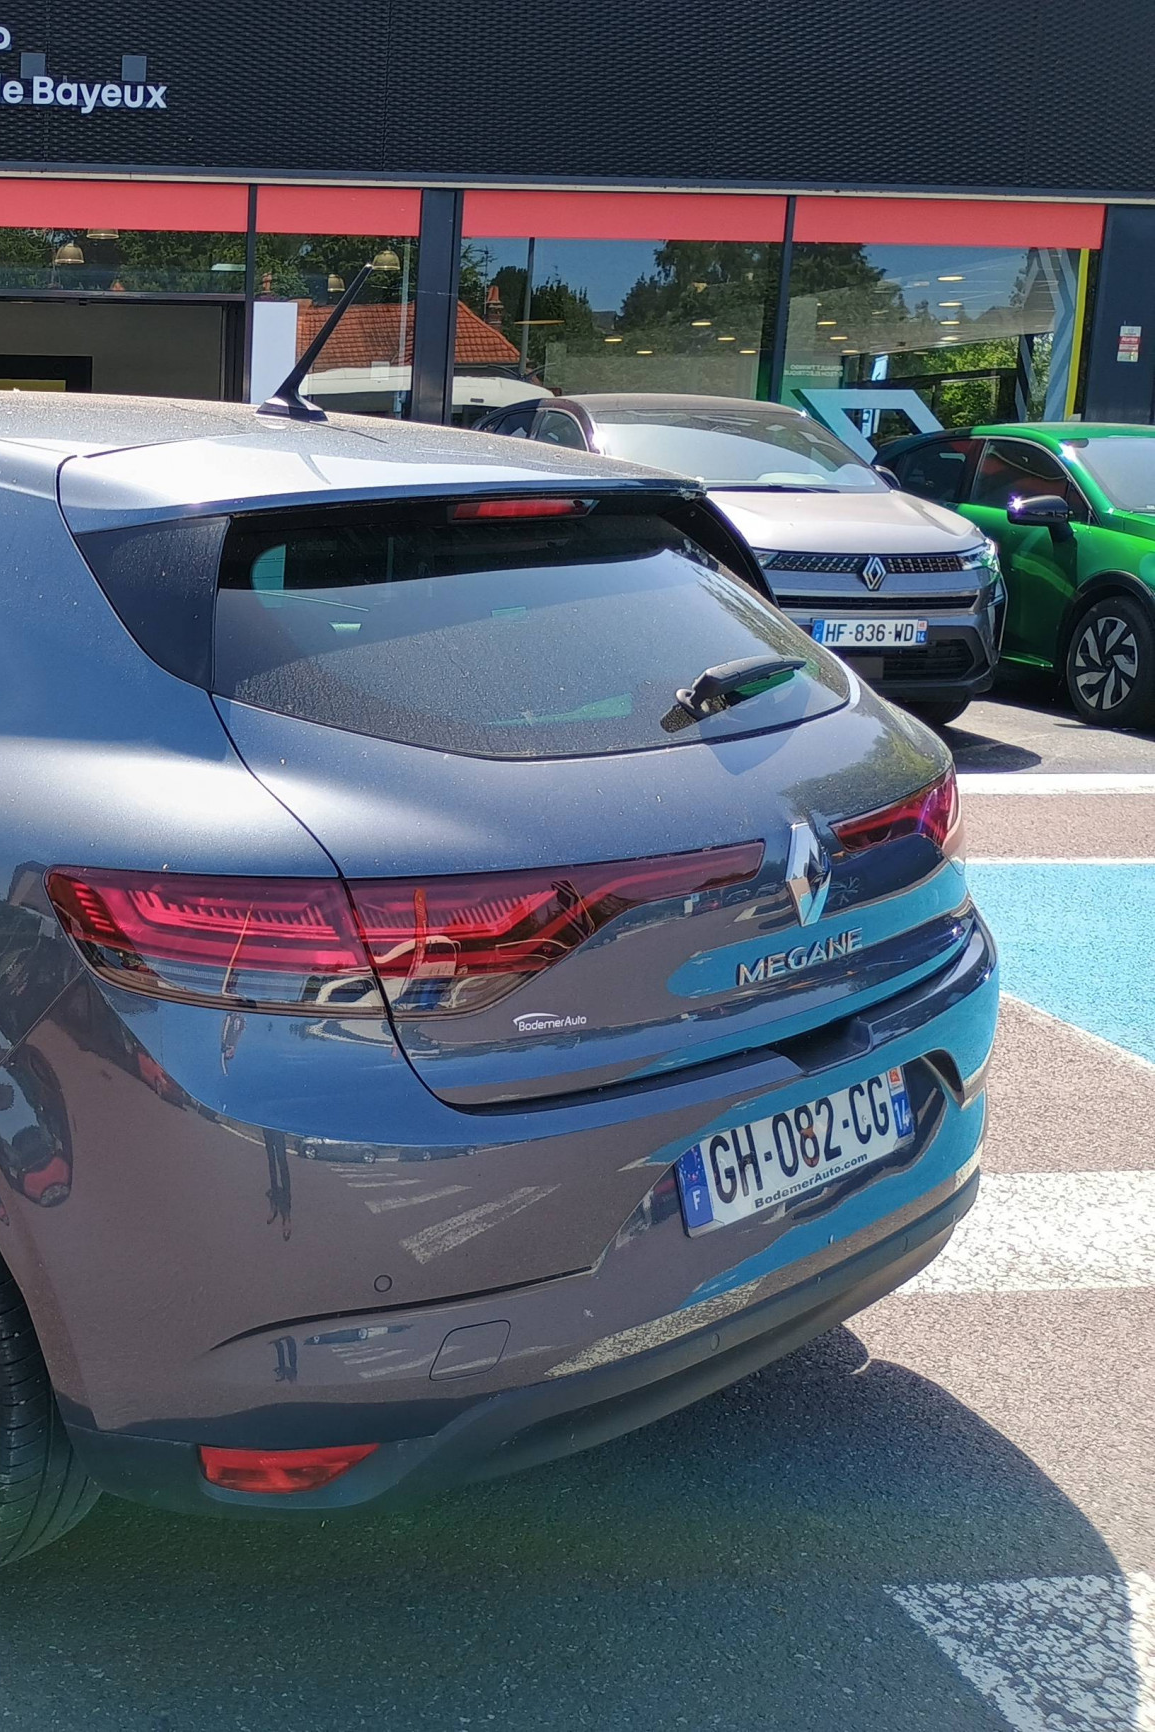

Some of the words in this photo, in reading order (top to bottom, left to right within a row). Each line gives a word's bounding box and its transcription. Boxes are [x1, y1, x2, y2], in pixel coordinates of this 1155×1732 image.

[32, 75, 168, 113] Bayeux
[824, 623, 915, 642] HF-836-WD
[736, 926, 864, 987] MEGANE
[518, 1015, 588, 1032] BodemerAuto
[894, 1102, 911, 1128] 14
[710, 1075, 890, 1204] GH-082-CG
[754, 1151, 869, 1209] BodemerAuto.com
[692, 1189, 701, 1212] F
